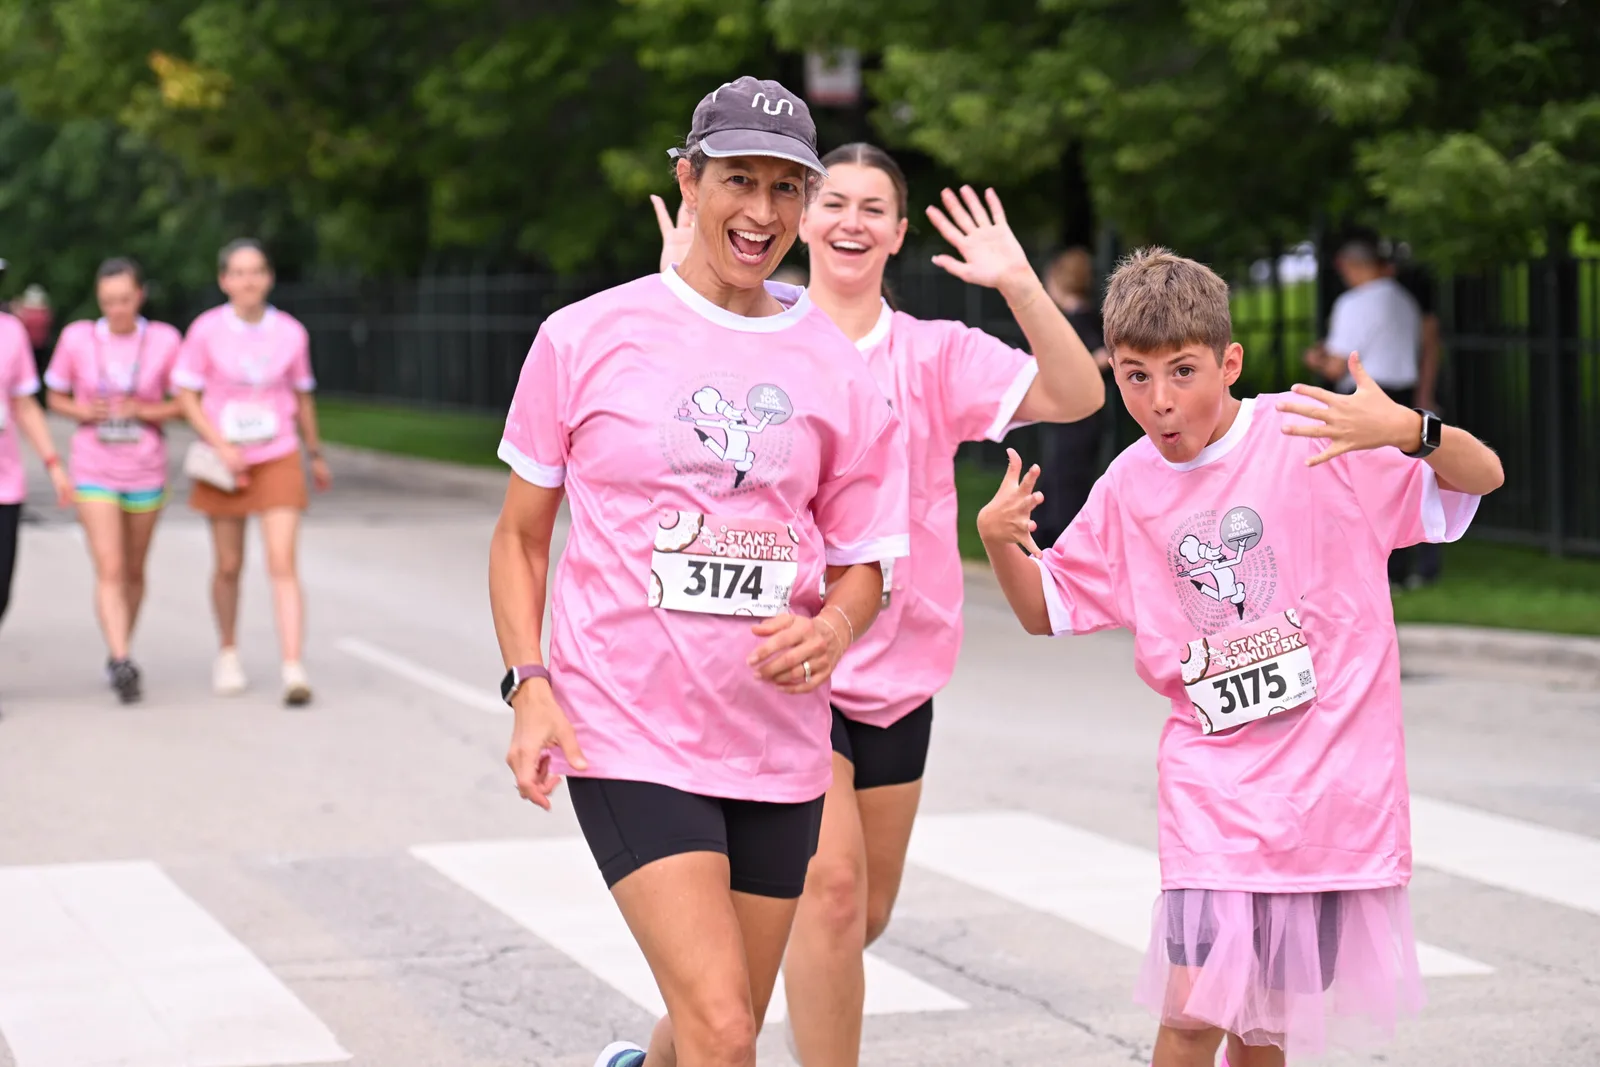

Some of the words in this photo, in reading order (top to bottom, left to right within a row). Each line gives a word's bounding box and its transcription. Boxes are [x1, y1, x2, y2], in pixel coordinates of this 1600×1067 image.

[760, 394, 780, 405] 10K
[1170, 516, 1192, 542] DONUT
[1194, 509, 1217, 520] RACE
[1197, 519, 1216, 528] RACE
[1229, 520, 1249, 532] 10K
[1231, 512, 1244, 522] 5K
[725, 530, 776, 546] STAN'S
[716, 544, 769, 559] DONUT
[772, 547, 793, 561] 5K
[1257, 550, 1268, 578] STAN'S
[1264, 546, 1277, 578] STAN'S
[684, 560, 762, 600] 3174
[1246, 579, 1259, 602] DONUT
[1252, 580, 1267, 608] DONUT
[1259, 581, 1277, 614] DONUT
[1227, 643, 1278, 669] DONUT
[1280, 633, 1303, 654] 5K
[1228, 628, 1280, 654] STAN'S
[1212, 662, 1287, 714] 3175
